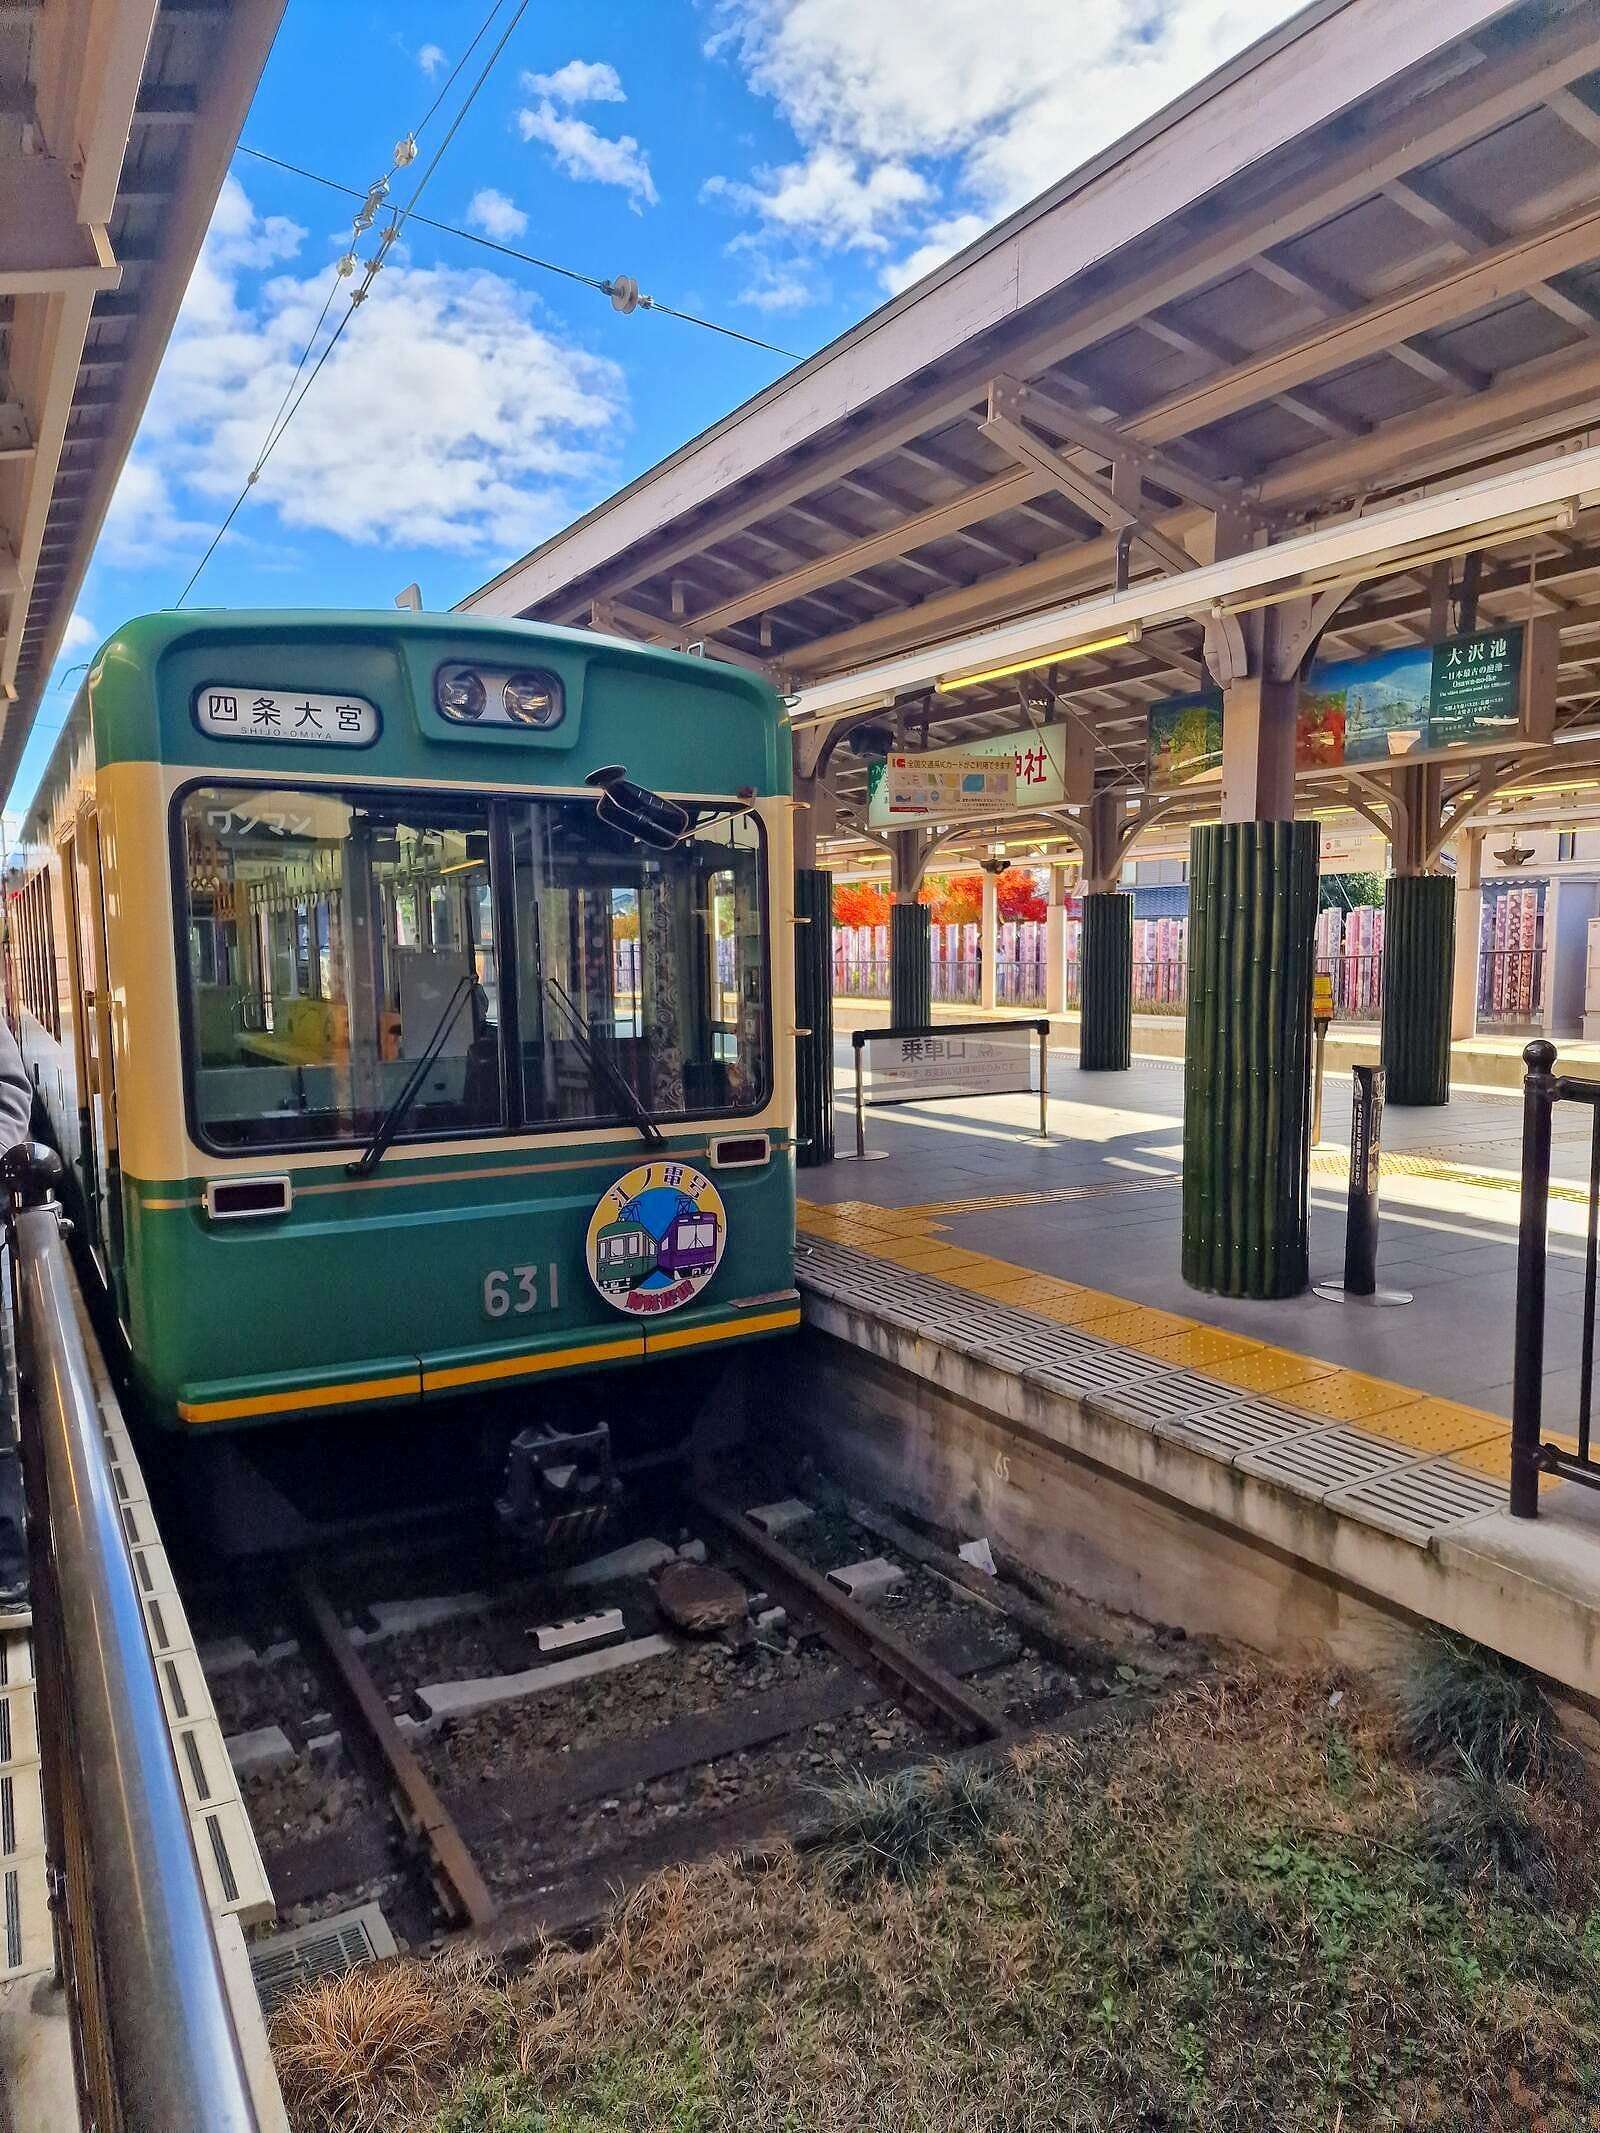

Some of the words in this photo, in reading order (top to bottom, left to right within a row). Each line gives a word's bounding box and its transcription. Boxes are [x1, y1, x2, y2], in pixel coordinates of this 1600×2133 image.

[1446, 638, 1507, 667] 大沢池
[208, 694, 363, 732] 四条大宮
[241, 726, 333, 740] SHIJO-OMIYA
[207, 810, 313, 836] ワンマン
[901, 1037, 967, 1064] 乗車口
[483, 1263, 560, 1318] 631
